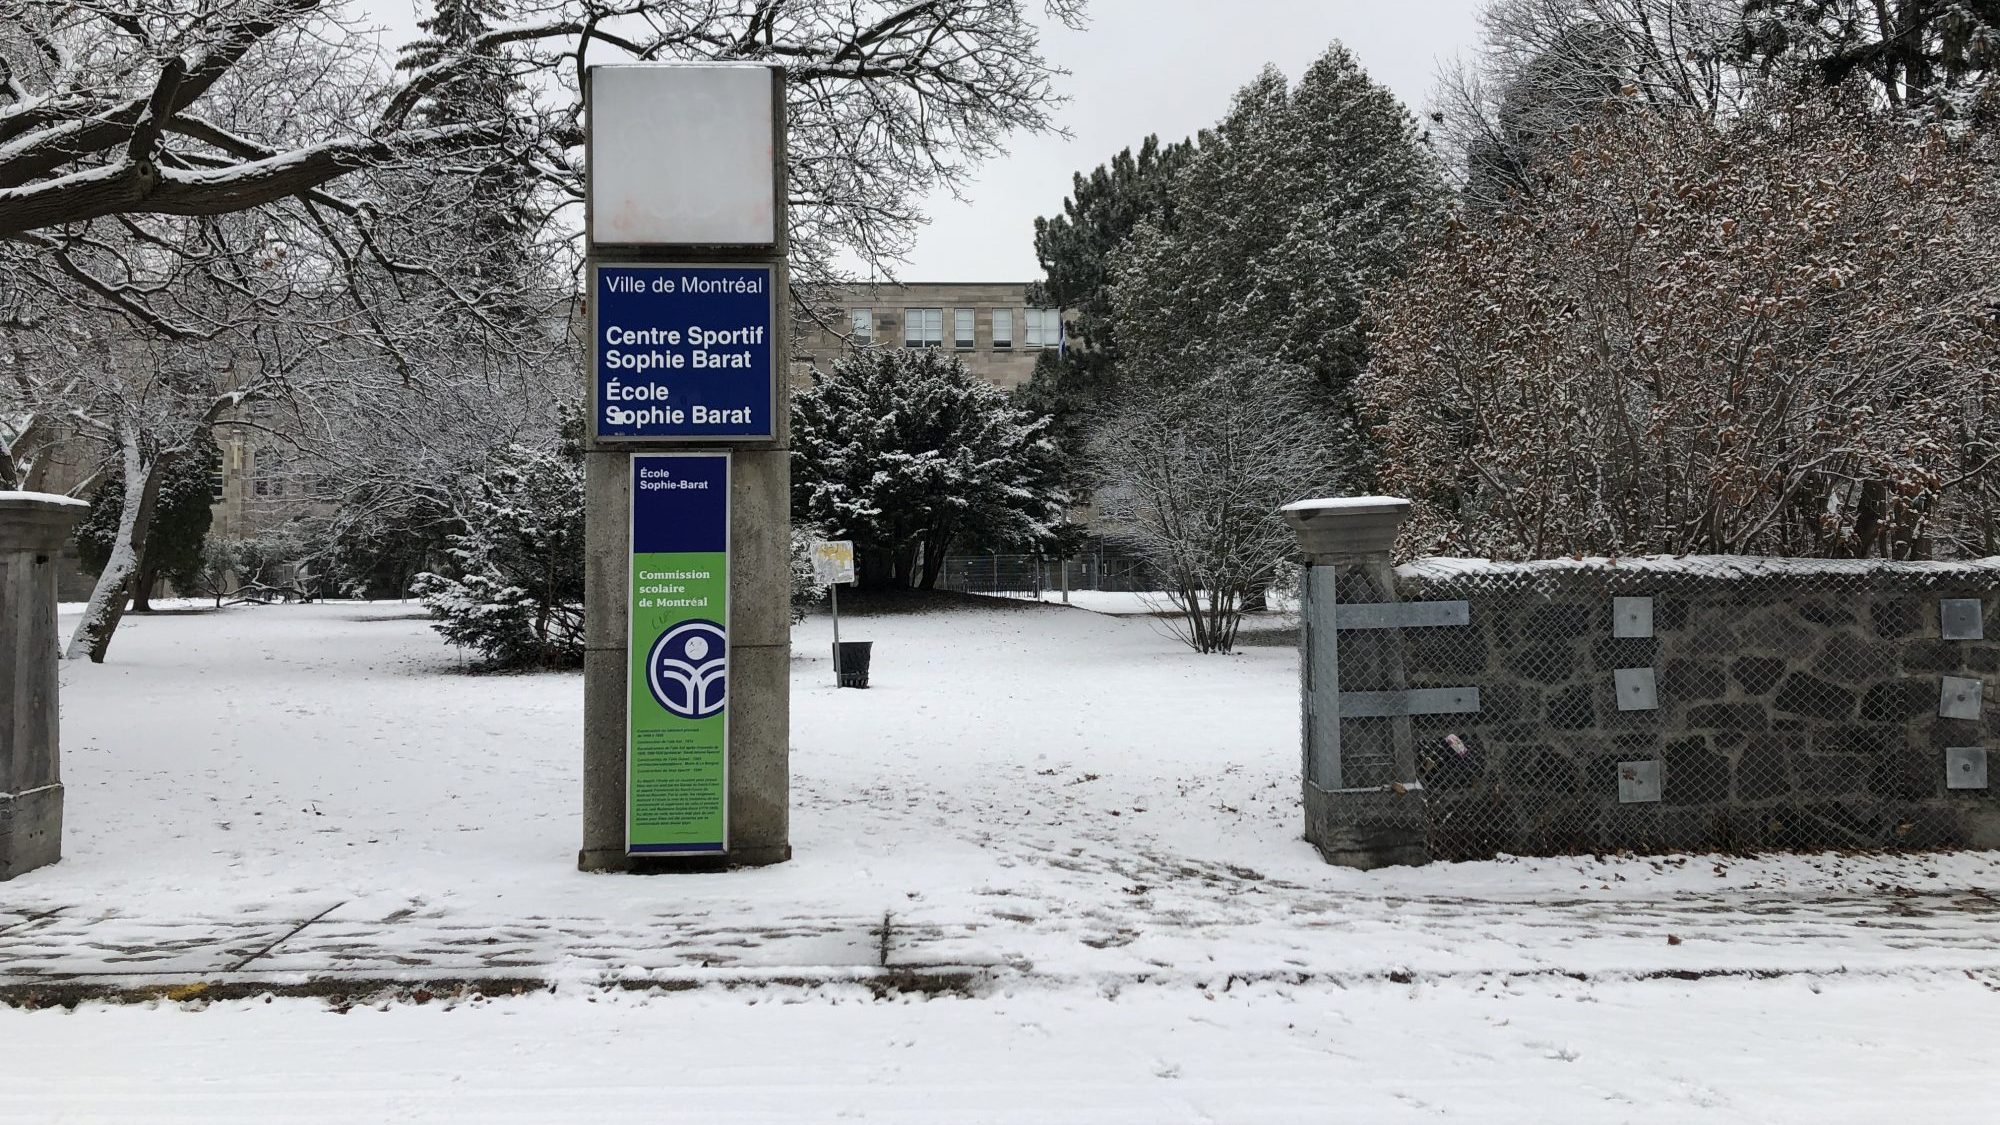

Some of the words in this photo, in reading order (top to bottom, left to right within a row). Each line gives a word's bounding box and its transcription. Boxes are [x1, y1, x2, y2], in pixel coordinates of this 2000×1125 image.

[606, 276, 646, 293] Ville
[651, 276, 675, 293] de
[681, 276, 762, 293] Montréal
[606, 326, 681, 345] Centre
[687, 326, 764, 349] Sportif
[606, 350, 685, 373] Sophie
[692, 350, 752, 369] Barat
[606, 377, 669, 401] École
[606, 406, 685, 429] Sophie
[692, 406, 752, 424] Barat
[640, 467, 670, 478] École
[640, 480, 708, 491] Sophie-Barat
[639, 570, 710, 580] Commission
[639, 583, 685, 593] scolaire
[638, 597, 653, 607] de
[656, 597, 708, 607] Montréal
